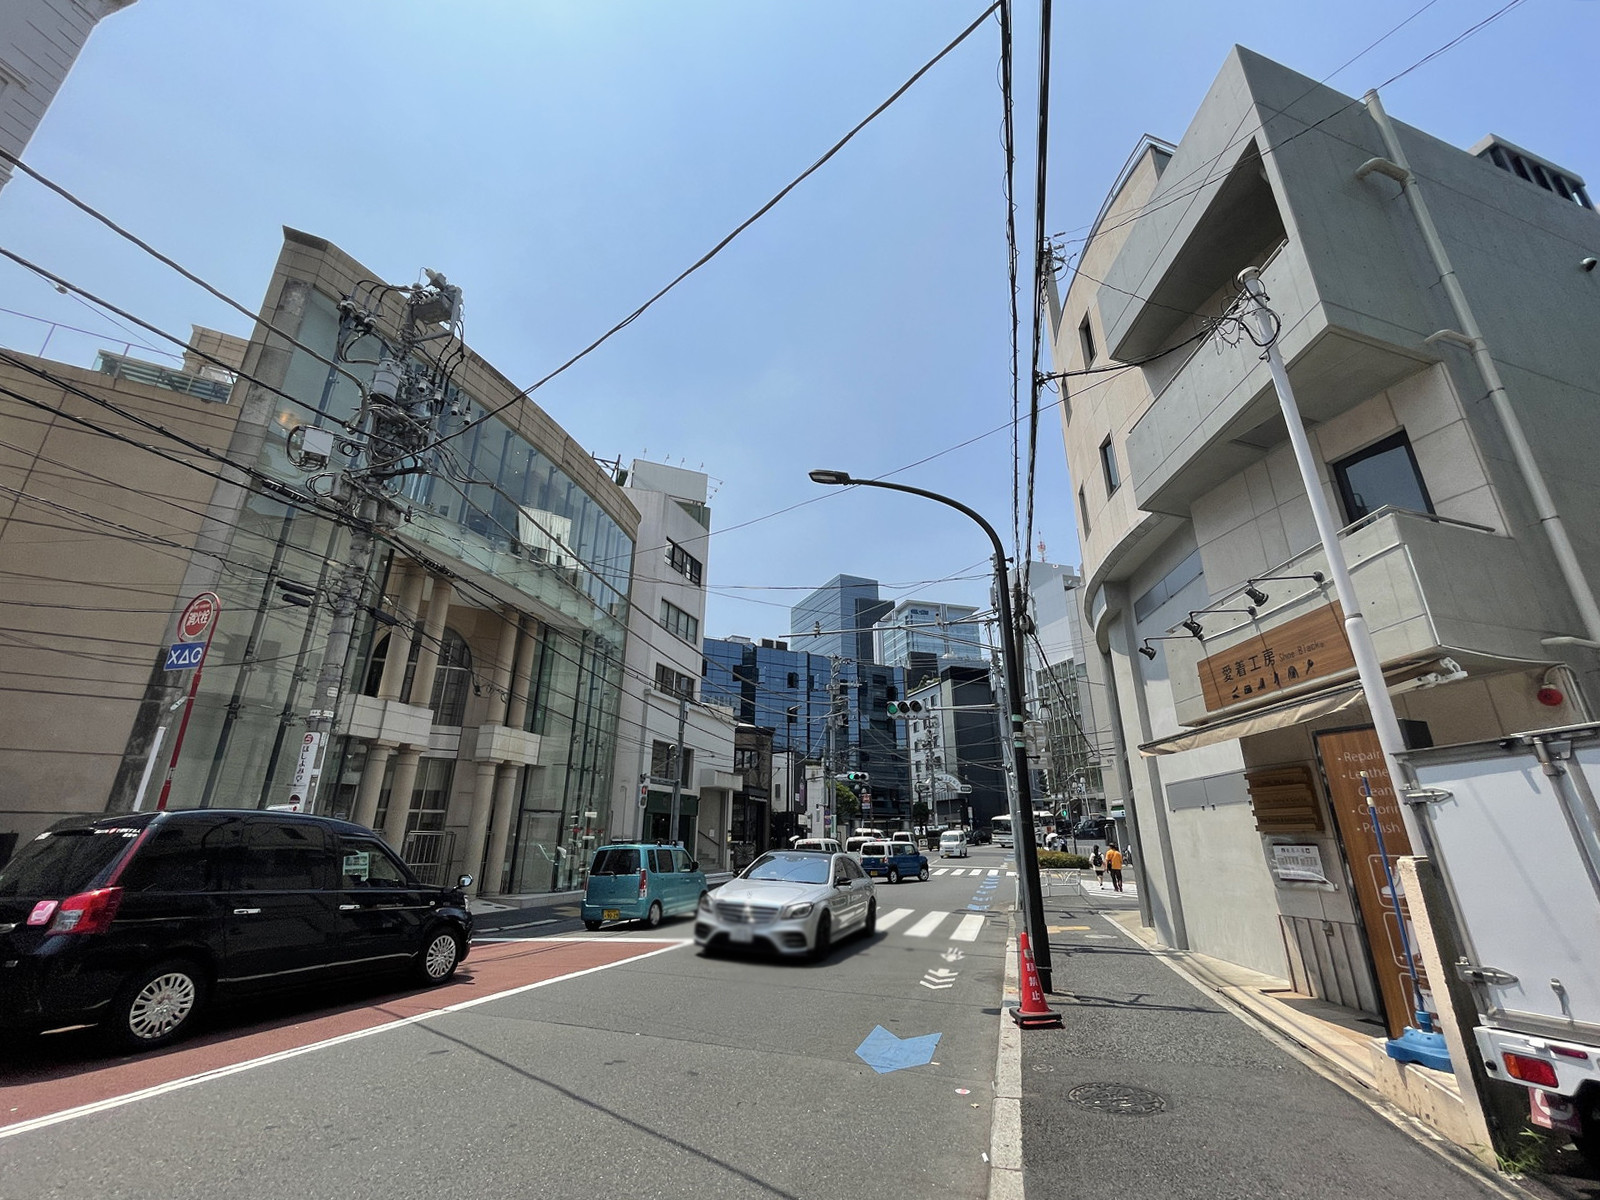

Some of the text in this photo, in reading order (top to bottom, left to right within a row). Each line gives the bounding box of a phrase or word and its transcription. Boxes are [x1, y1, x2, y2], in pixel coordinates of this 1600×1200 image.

[1221, 648, 1275, 683] 愛着工房
[1343, 750, 1381, 763] Repair
